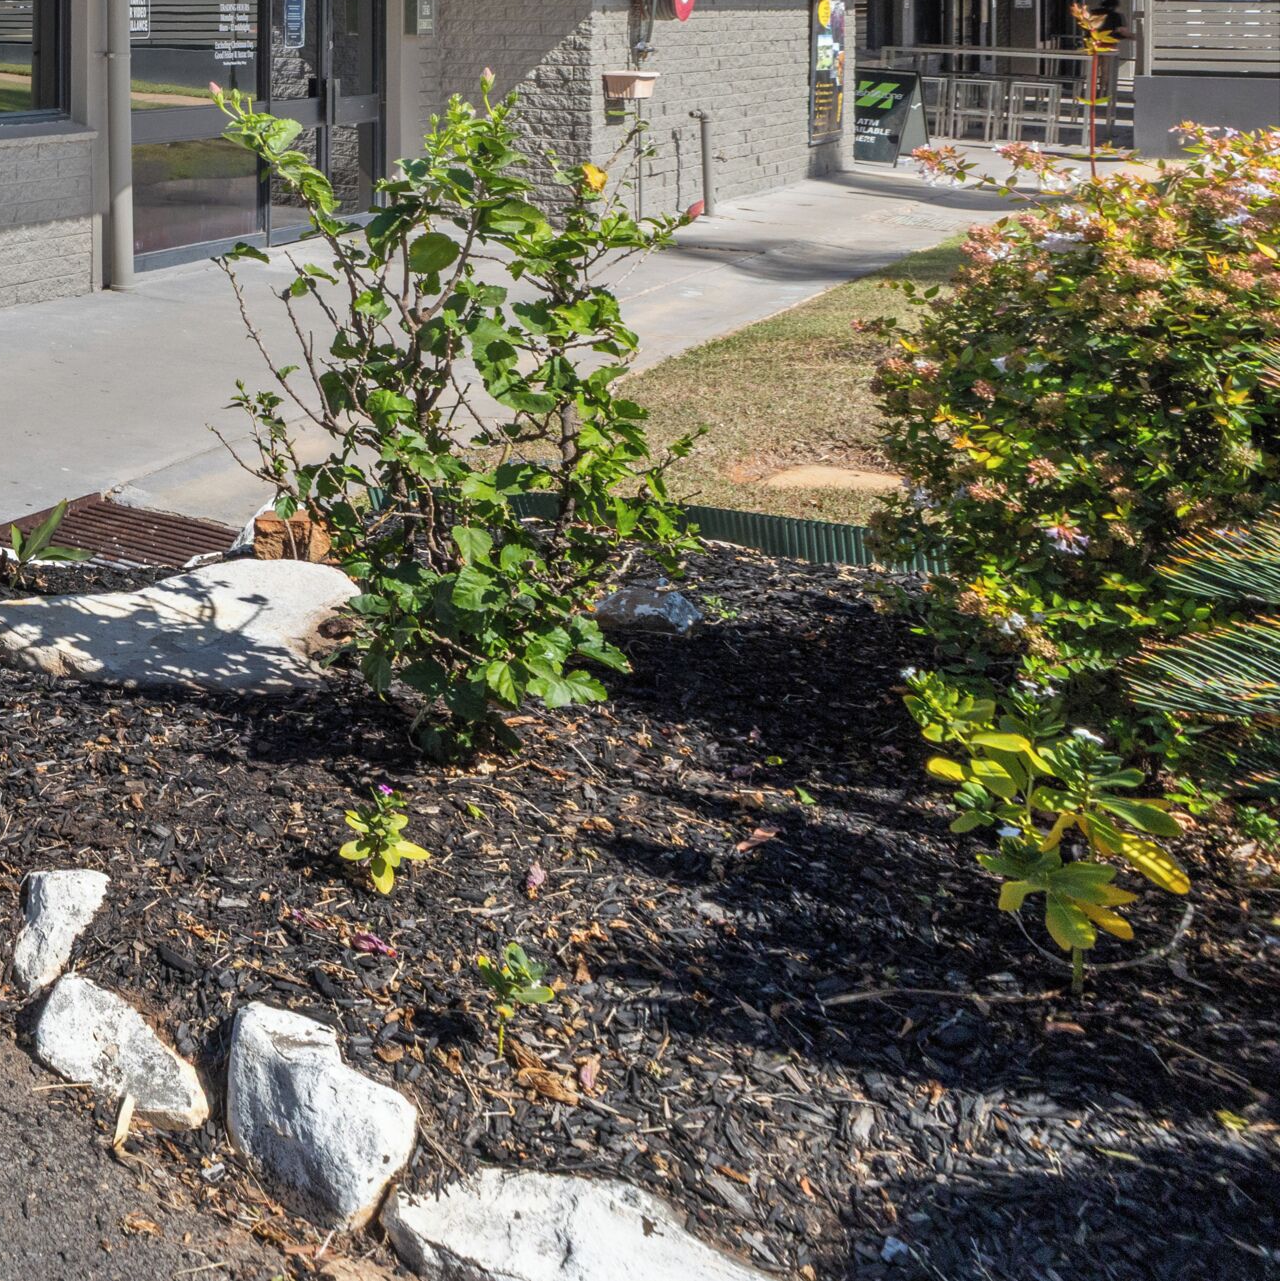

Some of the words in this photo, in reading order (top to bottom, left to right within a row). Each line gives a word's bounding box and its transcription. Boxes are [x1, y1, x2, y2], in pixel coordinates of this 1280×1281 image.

[134, 7, 146, 18] VIDEO
[857, 118, 880, 126] ATM
[854, 125, 892, 135] AILABLE
